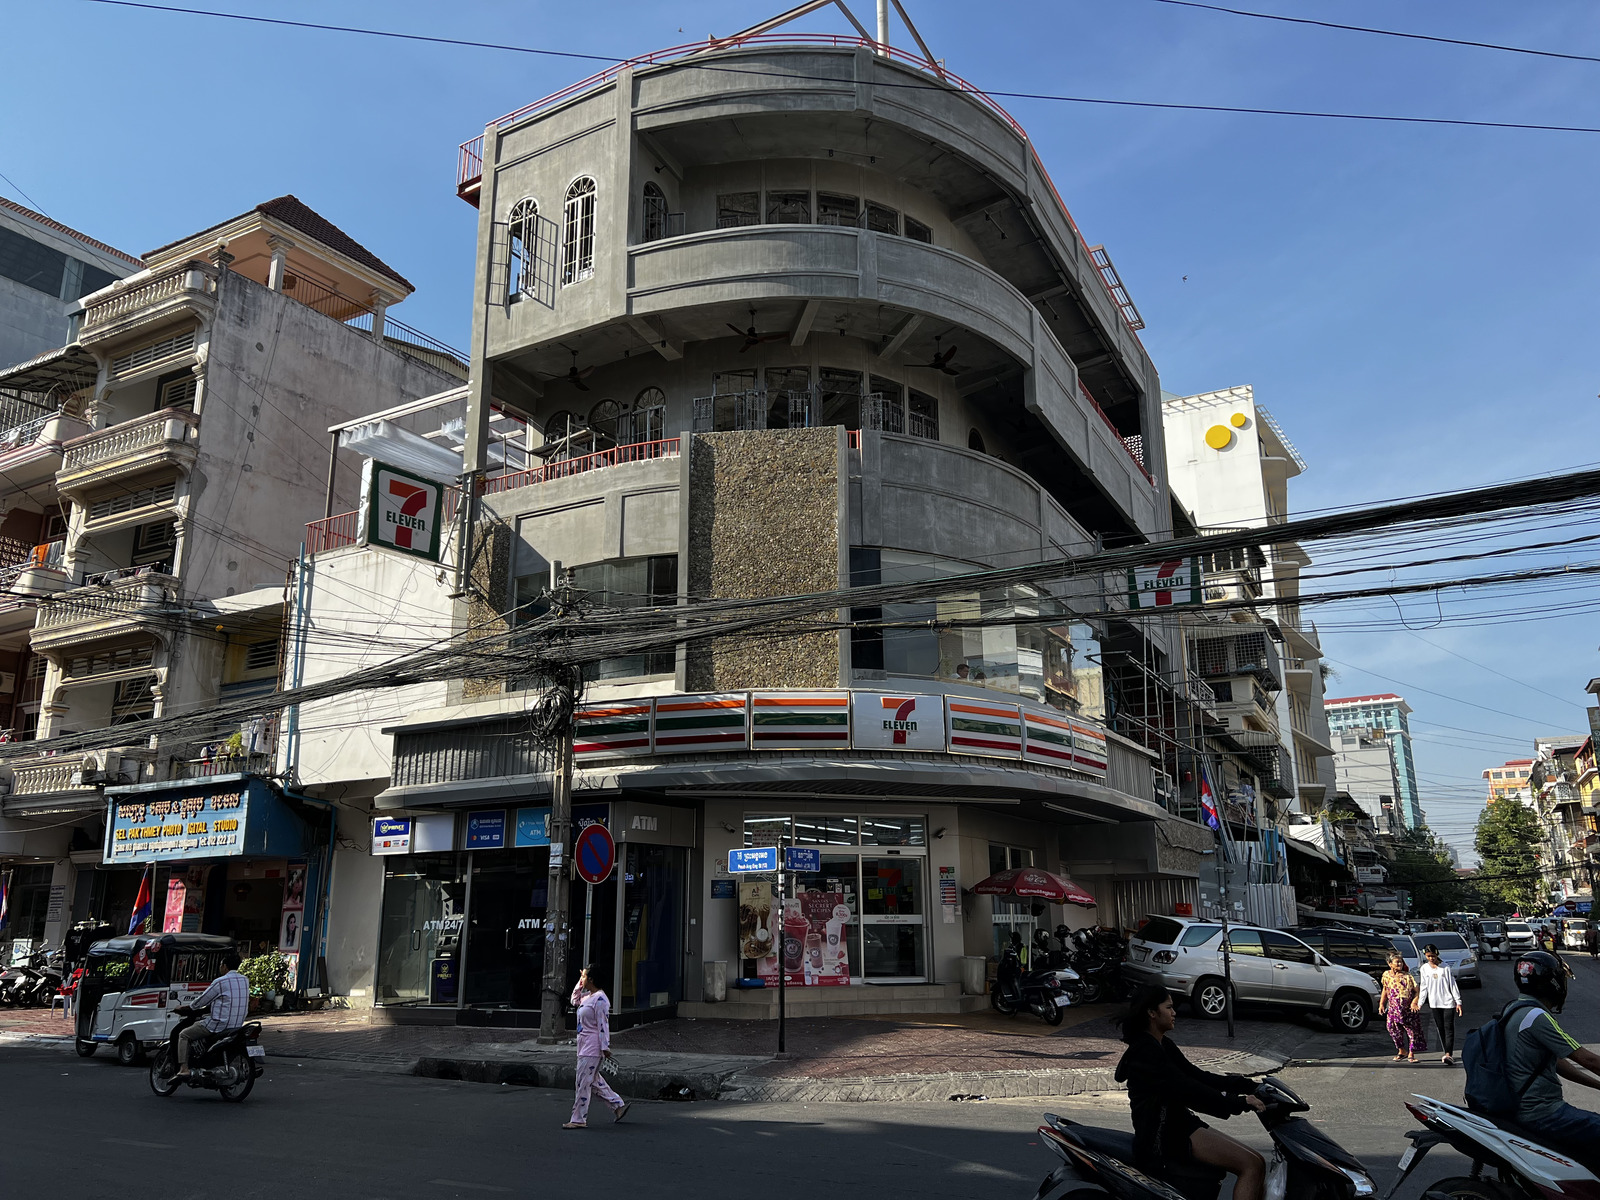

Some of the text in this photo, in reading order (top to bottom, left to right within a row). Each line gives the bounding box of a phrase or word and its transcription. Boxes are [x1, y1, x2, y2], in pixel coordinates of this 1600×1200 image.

[115, 829, 127, 840] SEL
[128, 827, 140, 839] PAK
[140, 826, 162, 839] THMEY
[163, 824, 183, 836] PHOTO
[213, 819, 239, 832] STUDIO
[631, 815, 658, 832] ATM
[423, 920, 443, 931] ATM
[517, 918, 539, 929] ATM
